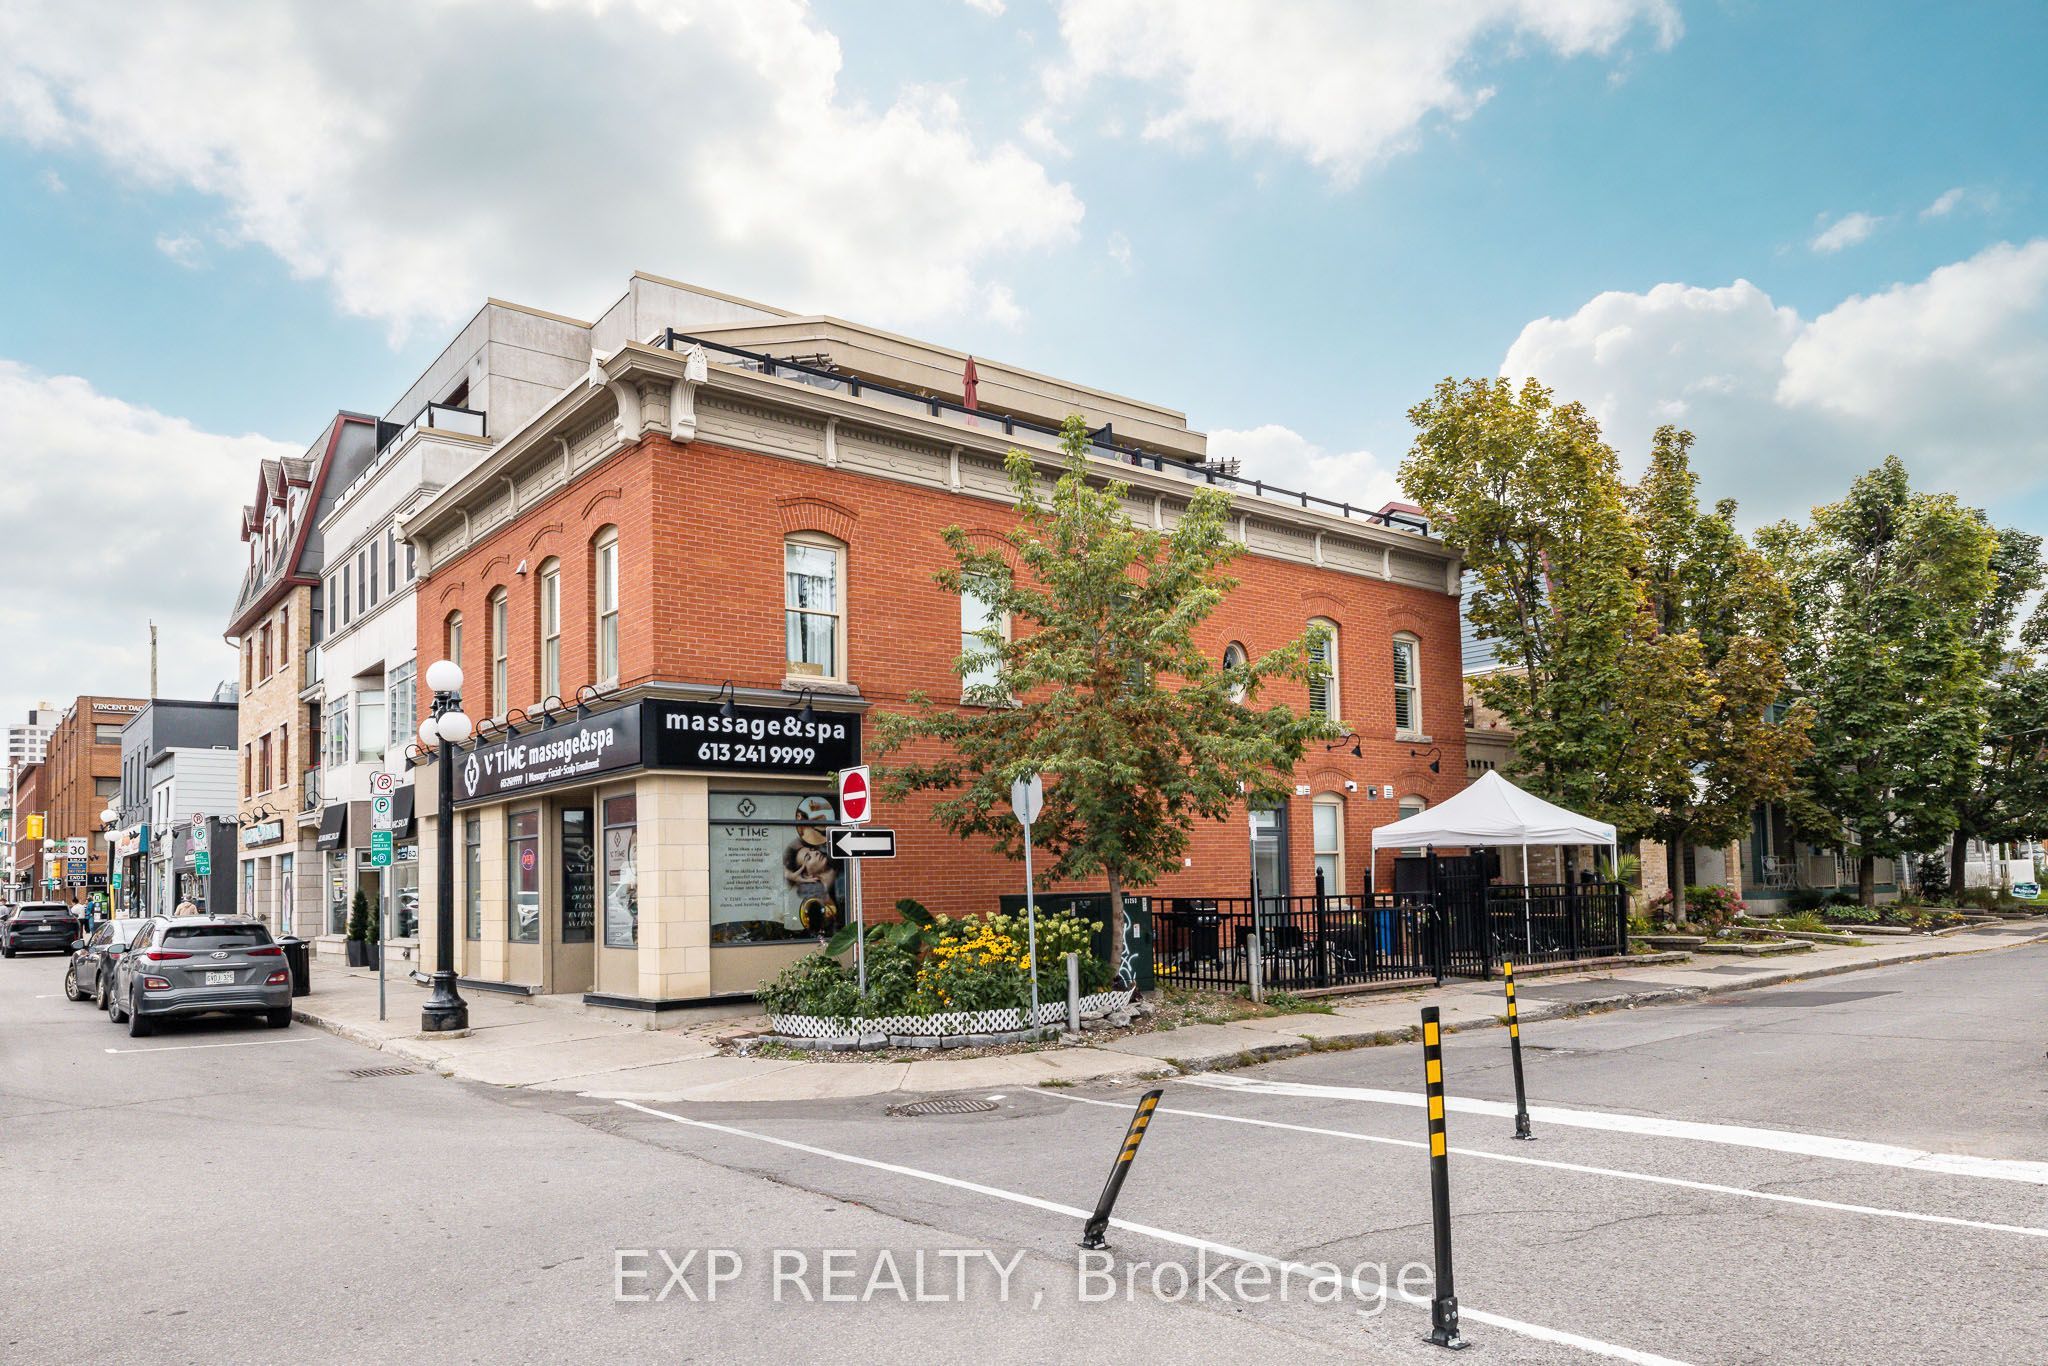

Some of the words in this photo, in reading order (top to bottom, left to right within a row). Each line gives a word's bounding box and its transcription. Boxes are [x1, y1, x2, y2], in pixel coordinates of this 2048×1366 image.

[93, 703, 127, 711] VINCENT
[666, 713, 845, 744] massage&spa
[495, 743, 527, 774] TIME
[529, 728, 614, 764] massage&spa
[697, 742, 731, 761] 613
[734, 744, 767, 763] 241
[769, 746, 816, 765] 9999
[738, 826, 768, 837] TIME
[70, 846, 85, 855] 30
